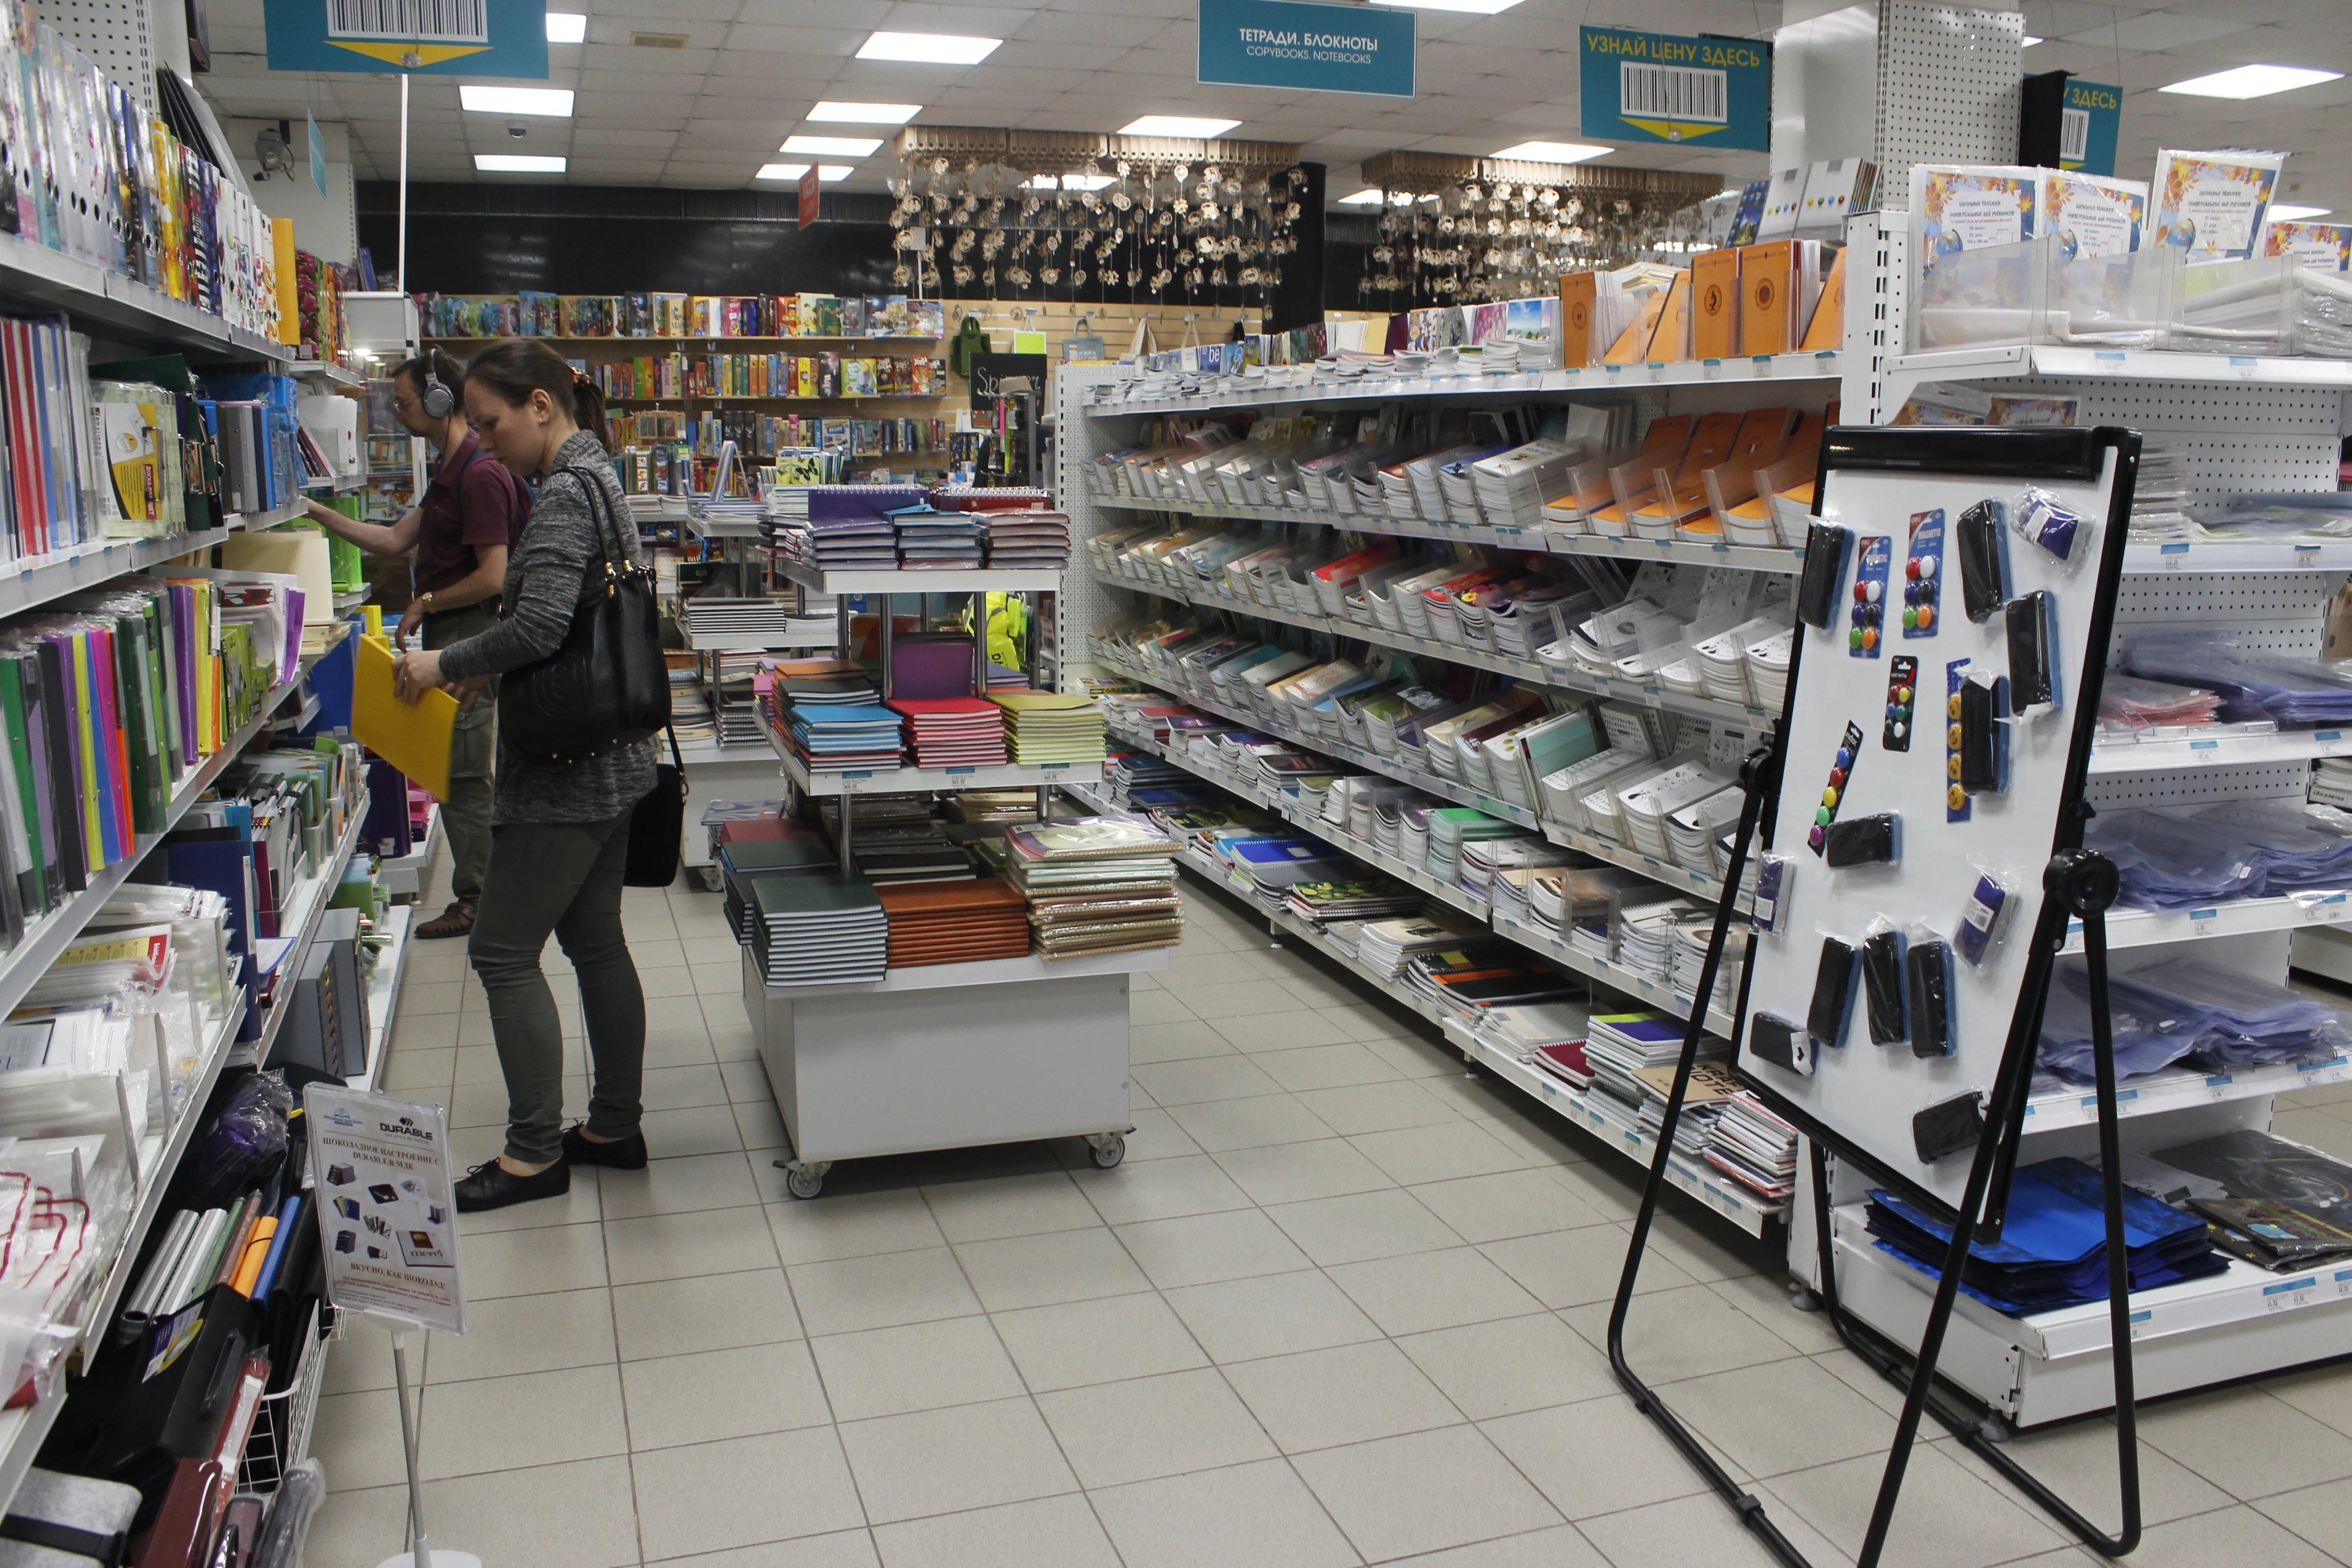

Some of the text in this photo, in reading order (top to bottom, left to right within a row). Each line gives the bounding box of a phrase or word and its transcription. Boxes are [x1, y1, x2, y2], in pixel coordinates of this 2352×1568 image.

[1239, 28, 1378, 51] ТЕТРАДИ. БЛОКНОТЫ
[1247, 46, 1371, 64] COPYBOOKS. NOTEBOOKS
[1587, 34, 1760, 67] УЗНАЙ ЦЕНУ ЗДЕСЬ
[2072, 88, 2117, 109] ЗДЕСЬ
[2068, 213, 2097, 221] УНИВЕРСАЛЬНЫЕ
[1209, 345, 1220, 362] be
[1918, 528, 1941, 540] MAGNETIC
[380, 1122, 433, 1141] DURABLE
[323, 1137, 378, 1154] ШОКОЛАДНОЕ
[381, 1148, 432, 1164] НАСТРОЕНИЕ
[353, 1152, 387, 1165] DURABLE
[396, 1161, 414, 1170] МДК
[410, 1250, 443, 1258] merci
[350, 1263, 385, 1276] ВКУСНО,
[387, 1270, 402, 1279] КАК
[404, 1274, 446, 1289] ШОКОЛАД!
